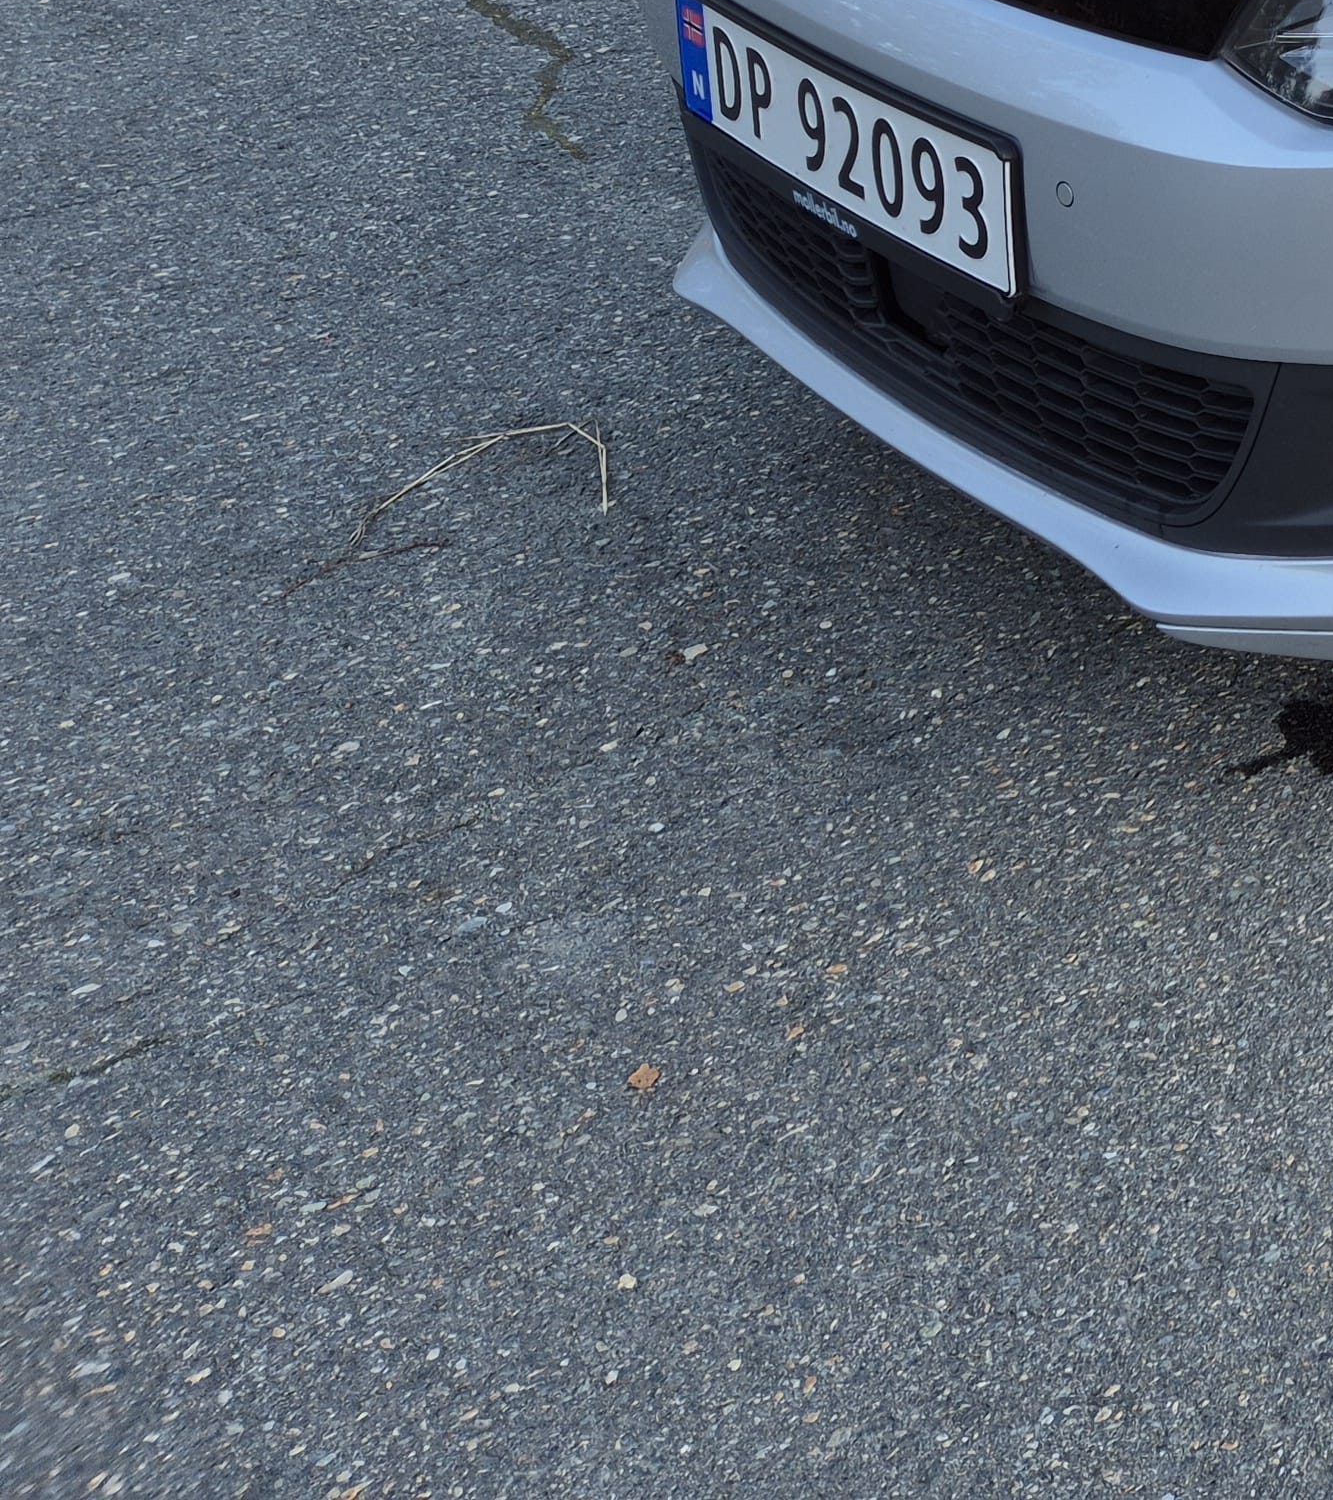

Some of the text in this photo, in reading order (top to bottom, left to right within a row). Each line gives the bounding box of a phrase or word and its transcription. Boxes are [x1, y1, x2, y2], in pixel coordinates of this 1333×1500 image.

[692, 26, 989, 260] N DP 92093
